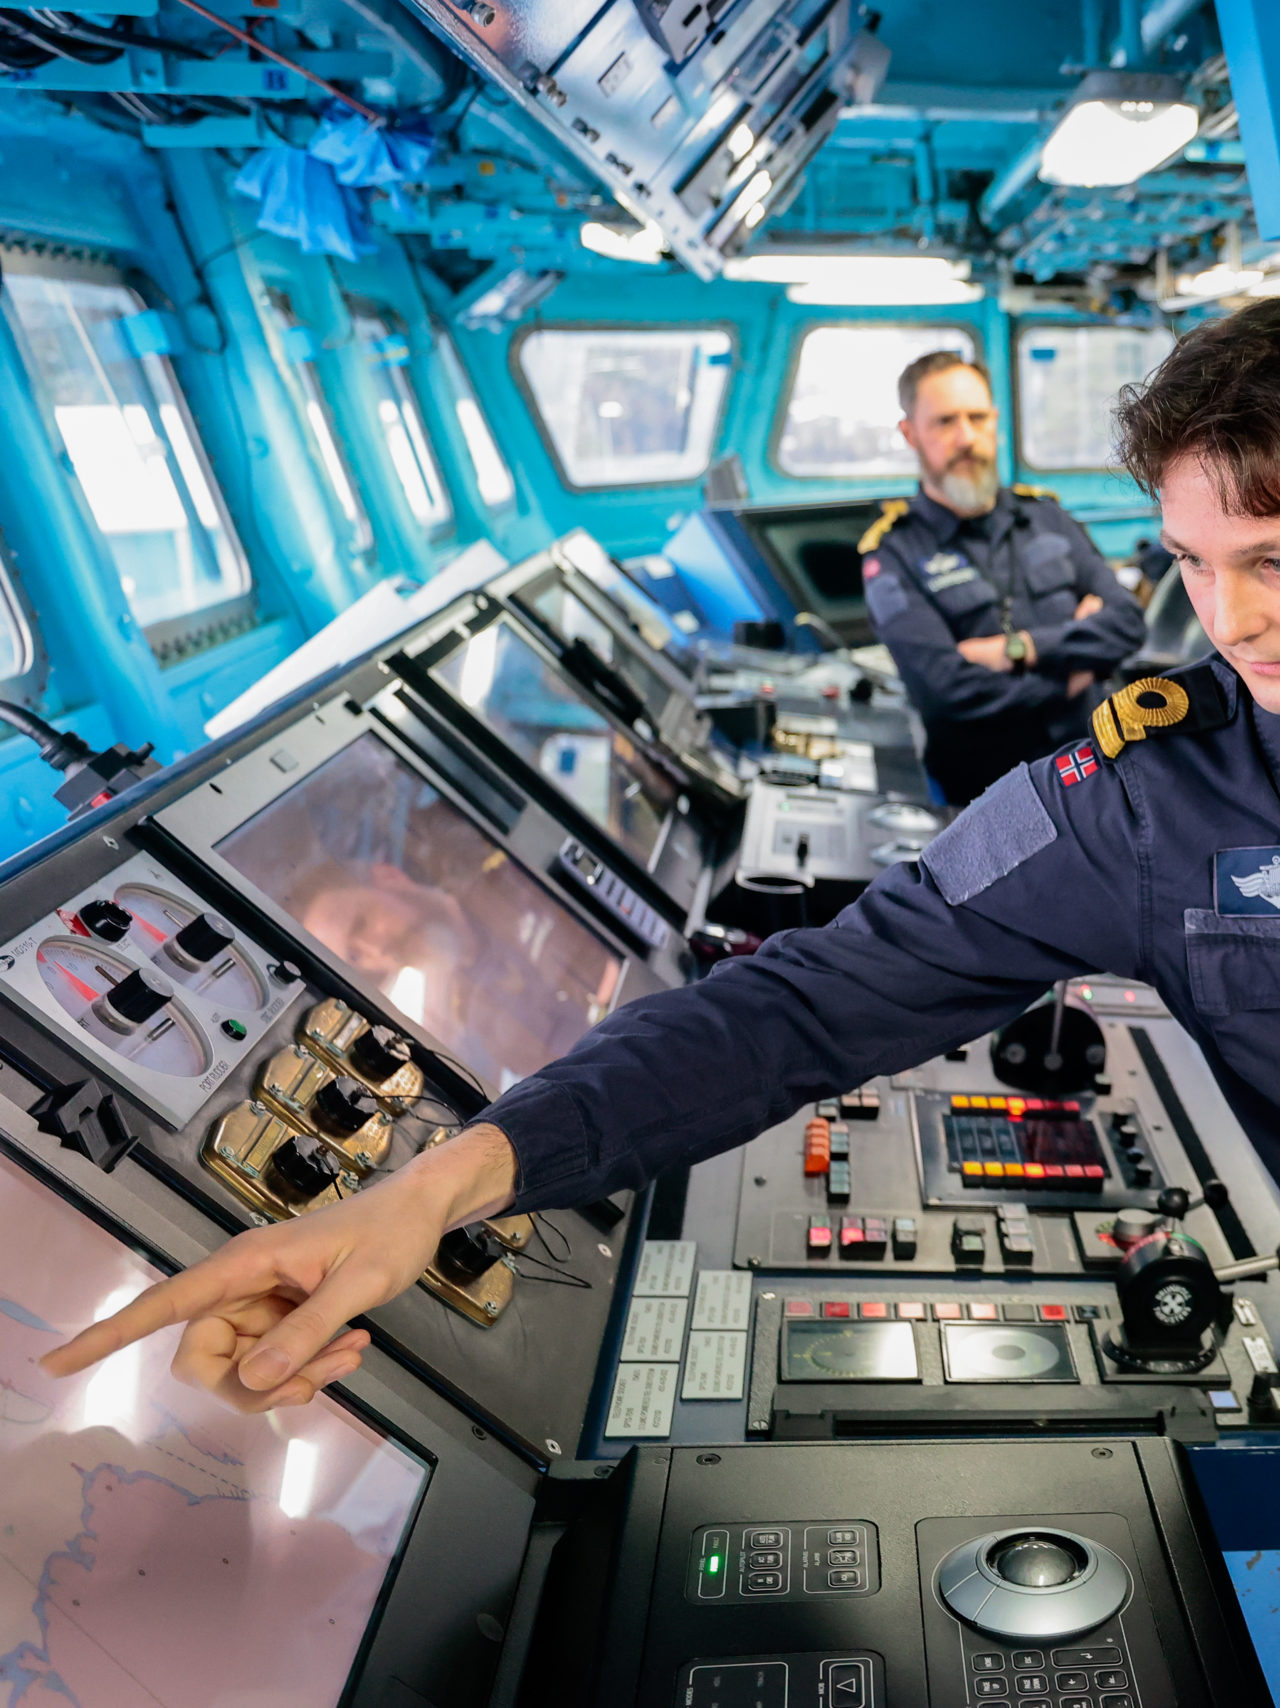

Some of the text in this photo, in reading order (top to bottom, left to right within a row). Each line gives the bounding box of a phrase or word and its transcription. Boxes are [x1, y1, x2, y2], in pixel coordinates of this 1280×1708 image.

[983, 1657, 993, 1668] HOME
[1023, 1656, 1032, 1664] ESC
[982, 1681, 991, 1692] PAGE
[1023, 1679, 1032, 1689] PAGE
[1032, 1678, 1041, 1689] DOWN
[686, 1687, 694, 1706] MODES
